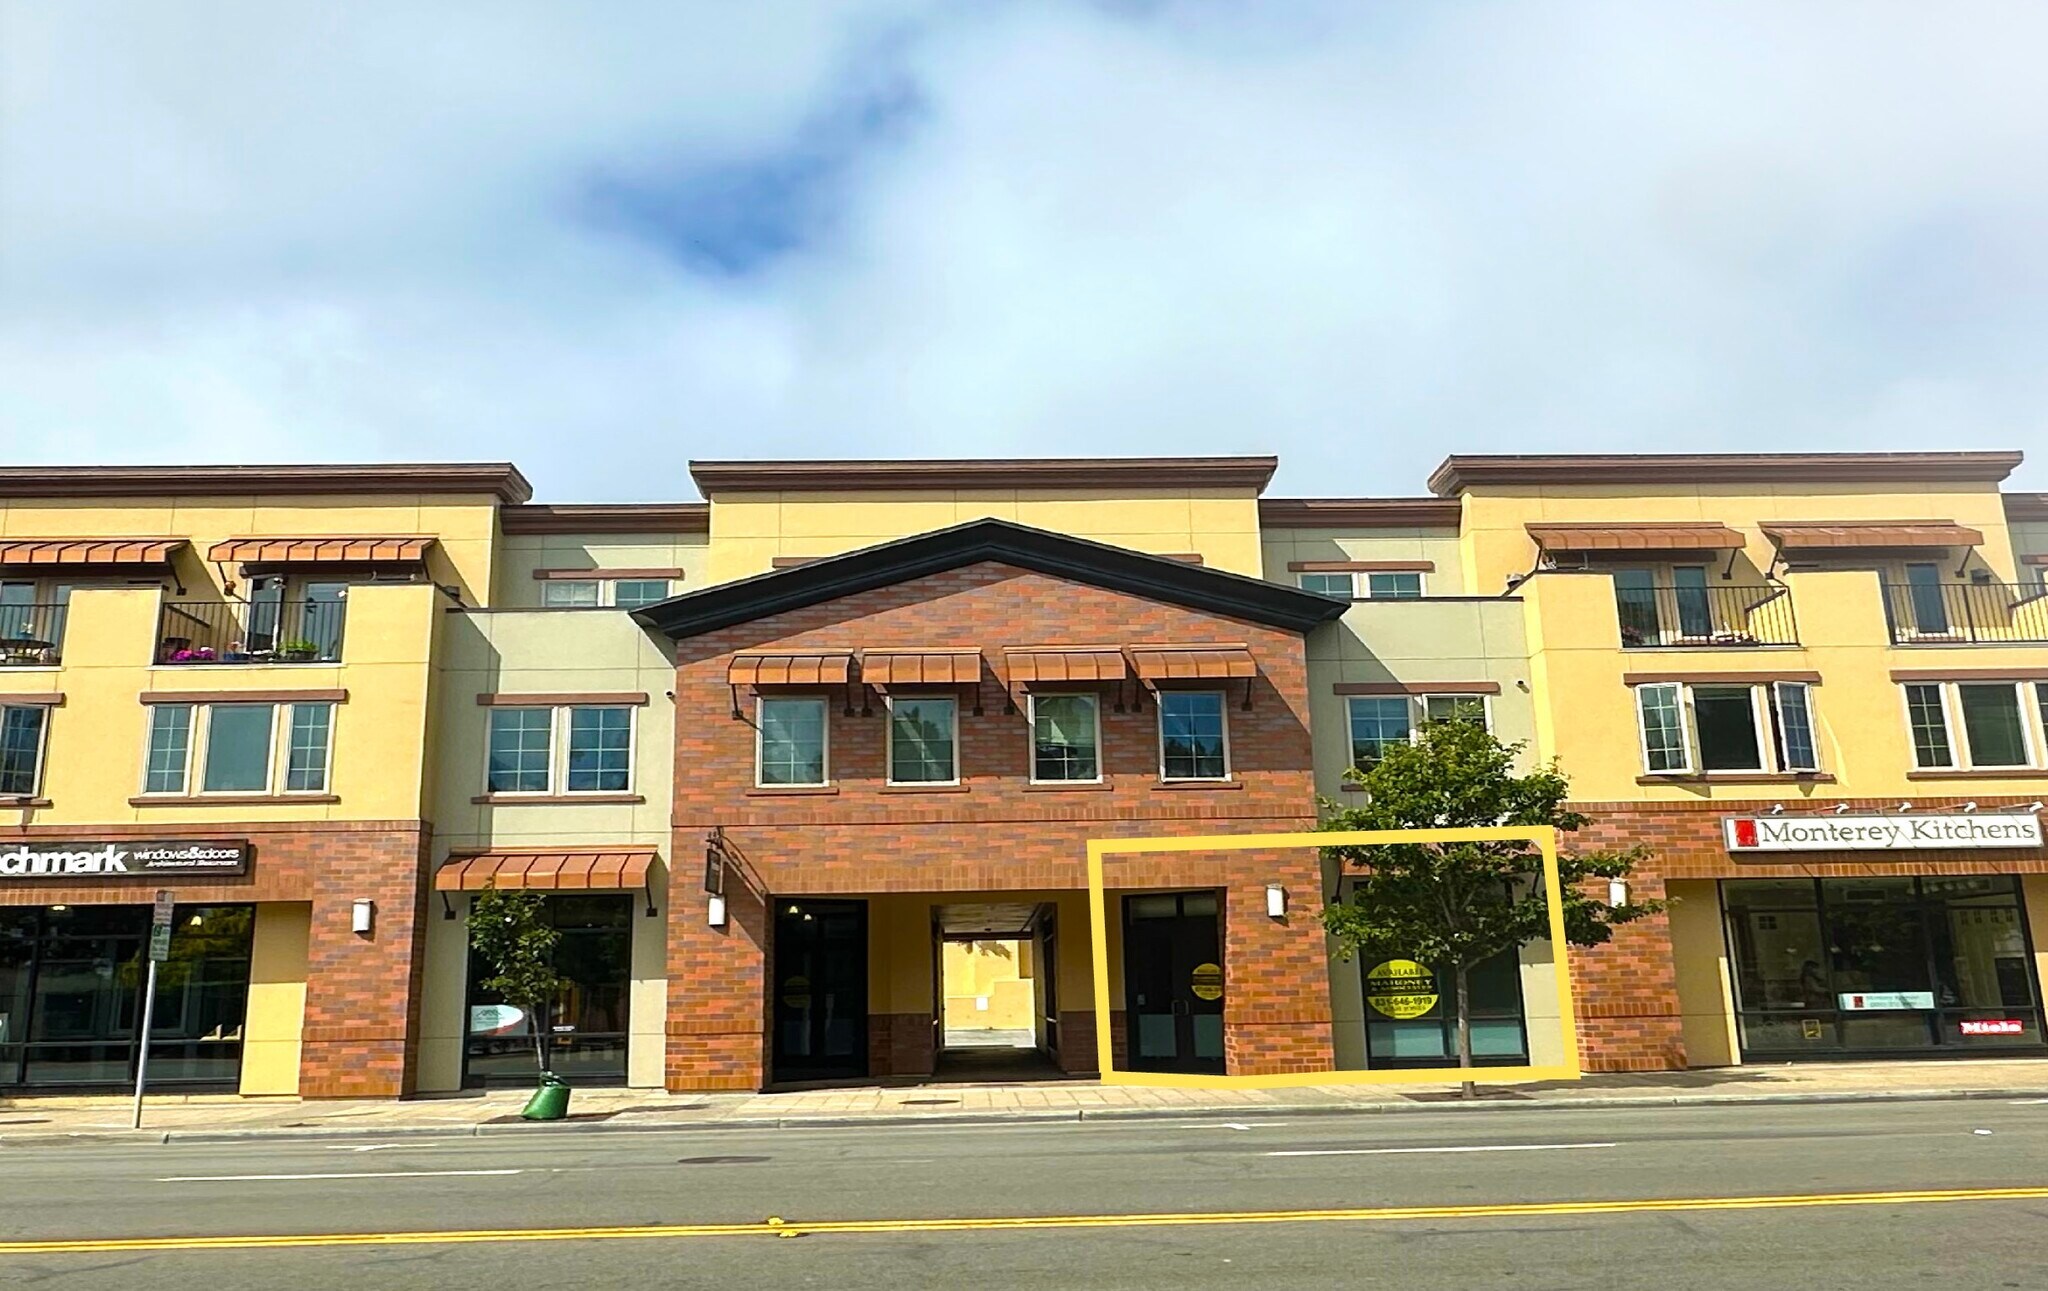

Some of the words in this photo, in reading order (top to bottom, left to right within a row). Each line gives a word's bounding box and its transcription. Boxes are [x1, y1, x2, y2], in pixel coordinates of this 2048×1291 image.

[1761, 821, 1900, 848] Monterey
[1909, 818, 2035, 841] Kitchens
[0, 844, 128, 874] chmark
[1377, 968, 1424, 977] AVAILABLE
